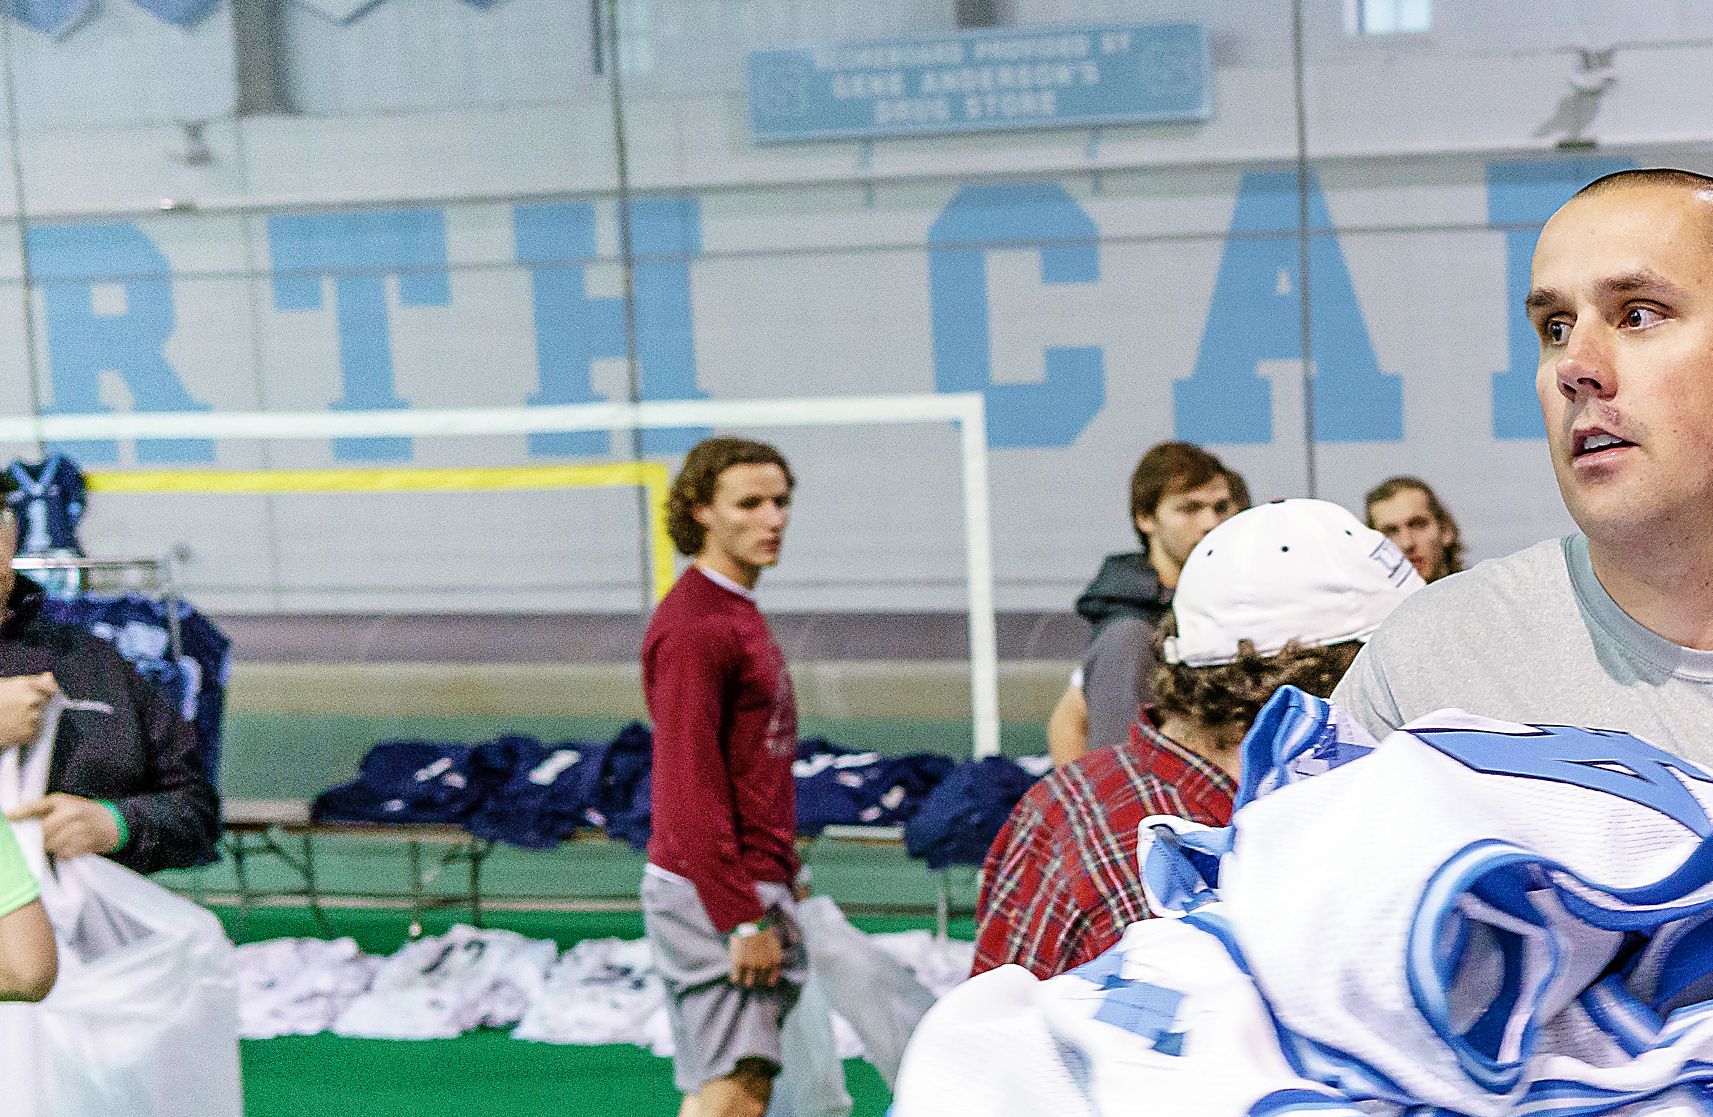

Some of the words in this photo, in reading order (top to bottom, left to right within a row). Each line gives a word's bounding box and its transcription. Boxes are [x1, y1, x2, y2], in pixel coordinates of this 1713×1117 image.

[974, 33, 1090, 63] PROVIDED
[1100, 31, 1134, 54] BY
[831, 71, 905, 98] GENE
[920, 61, 1100, 94] ANDERSON'S
[873, 98, 950, 124] DRUG
[965, 89, 1058, 119] STORE
